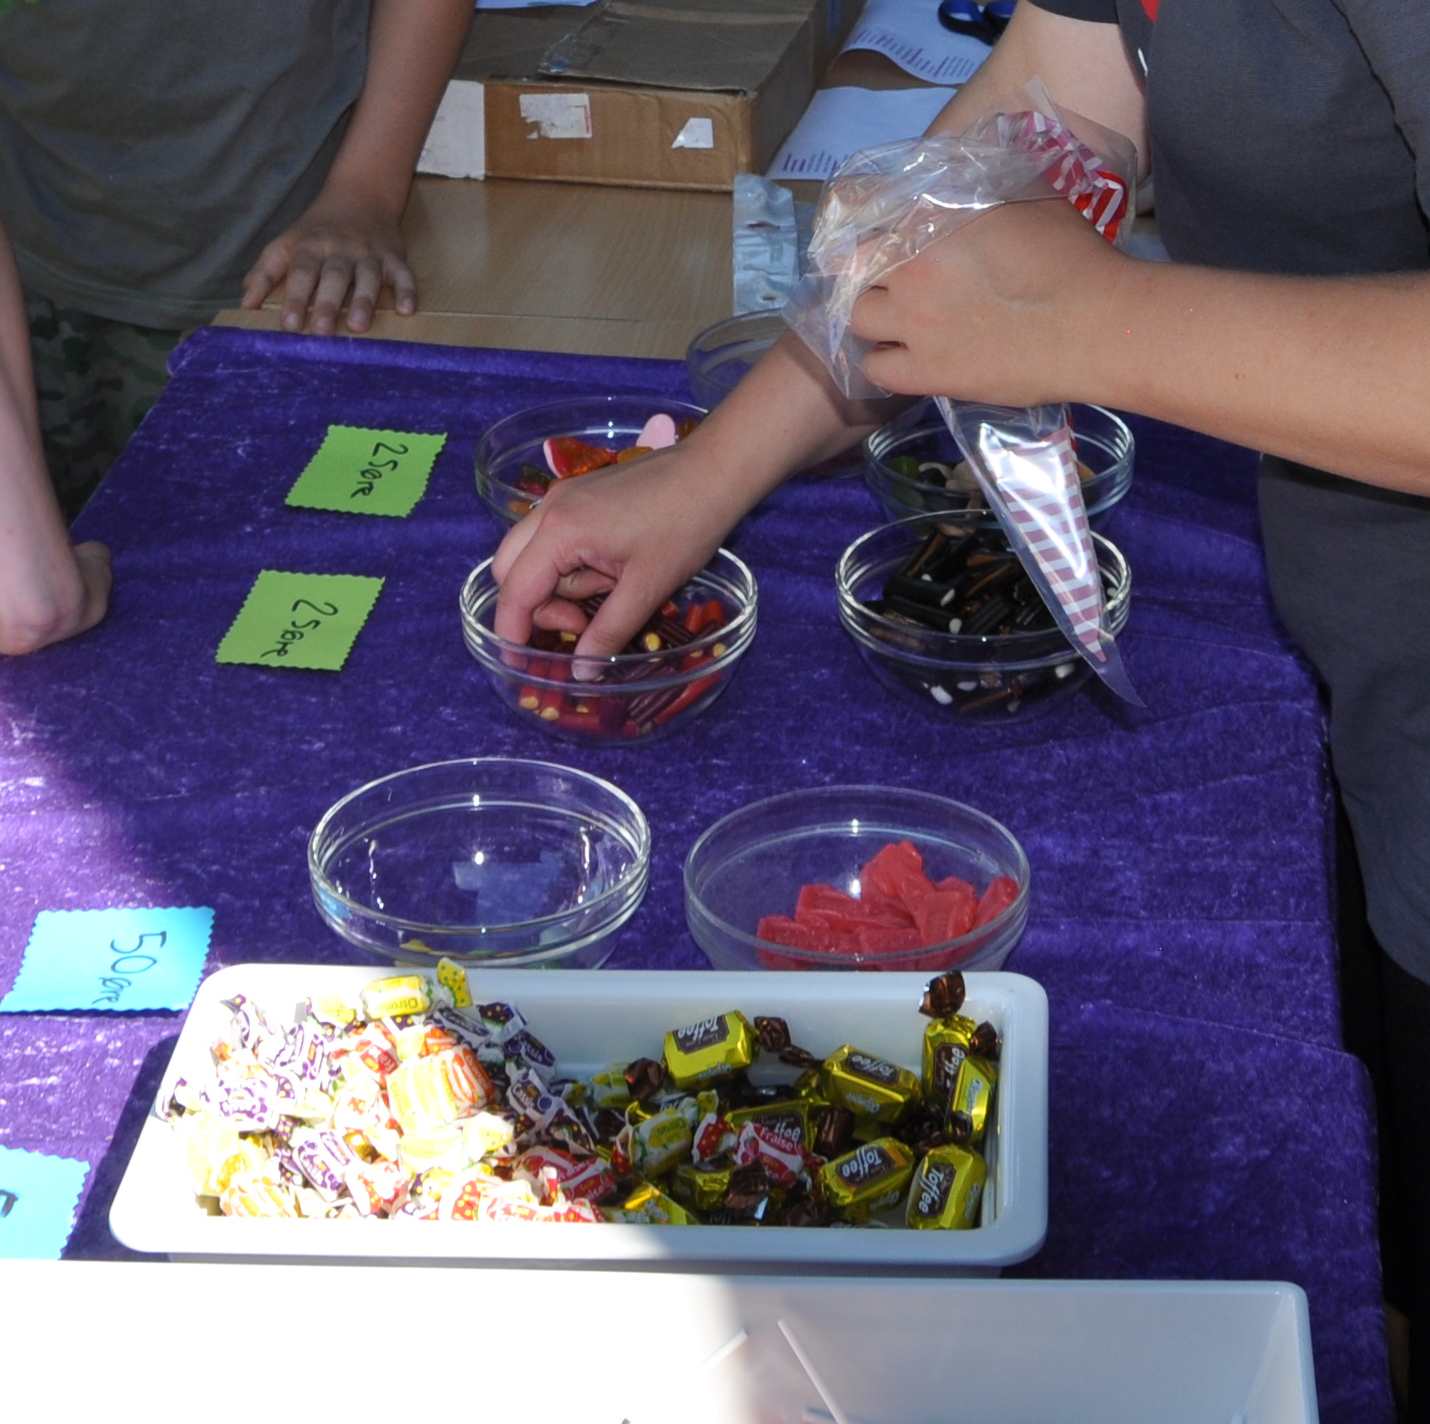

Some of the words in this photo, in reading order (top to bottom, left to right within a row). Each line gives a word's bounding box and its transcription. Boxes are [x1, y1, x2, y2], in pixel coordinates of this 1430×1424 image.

[109, 930, 167, 974] 50
[852, 1053, 895, 1077] Toffee
[759, 1127, 795, 1152] Fraise
[841, 1146, 884, 1178] Toffee
[917, 1167, 945, 1215] Toffee
